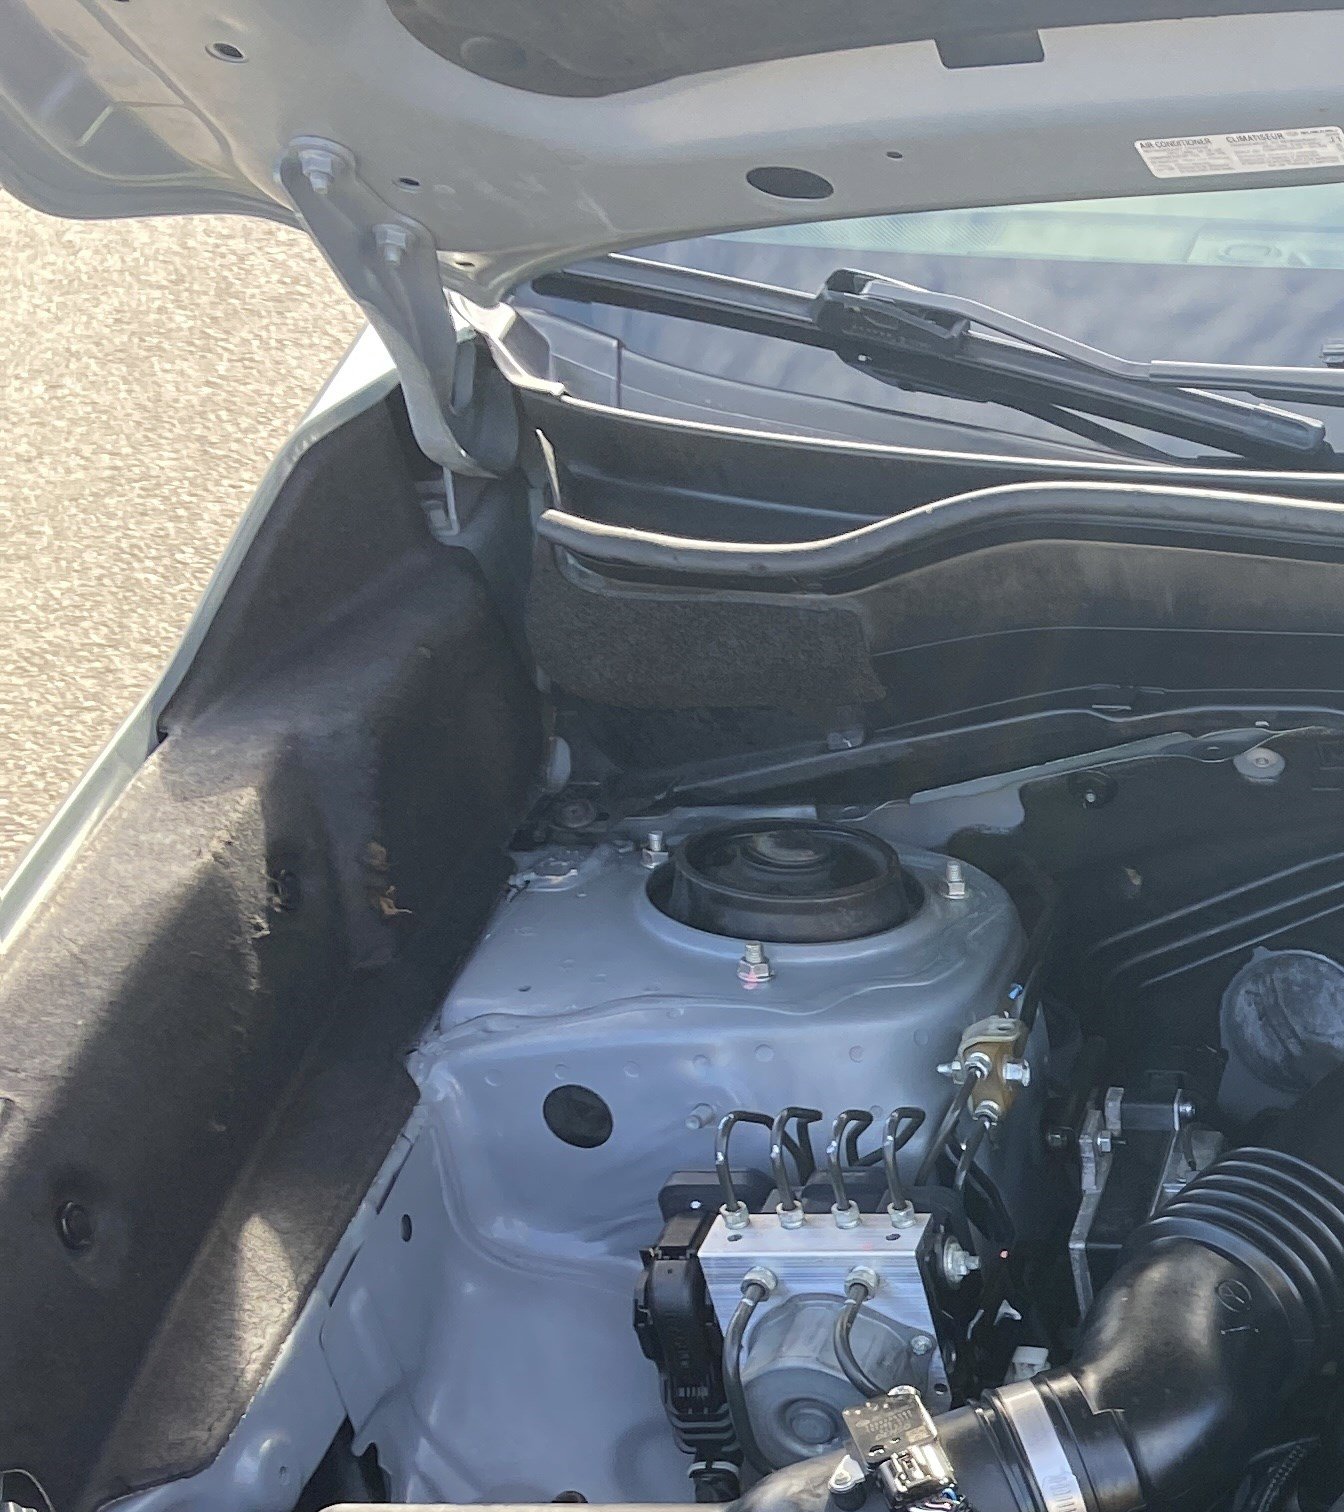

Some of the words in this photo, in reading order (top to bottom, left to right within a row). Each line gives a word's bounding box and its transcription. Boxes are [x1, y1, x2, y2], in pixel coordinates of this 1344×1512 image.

[1140, 141, 1154, 149] AIR
[1155, 137, 1212, 148] CONDITIONER
[1225, 132, 1284, 144] CLIMATISEUR
